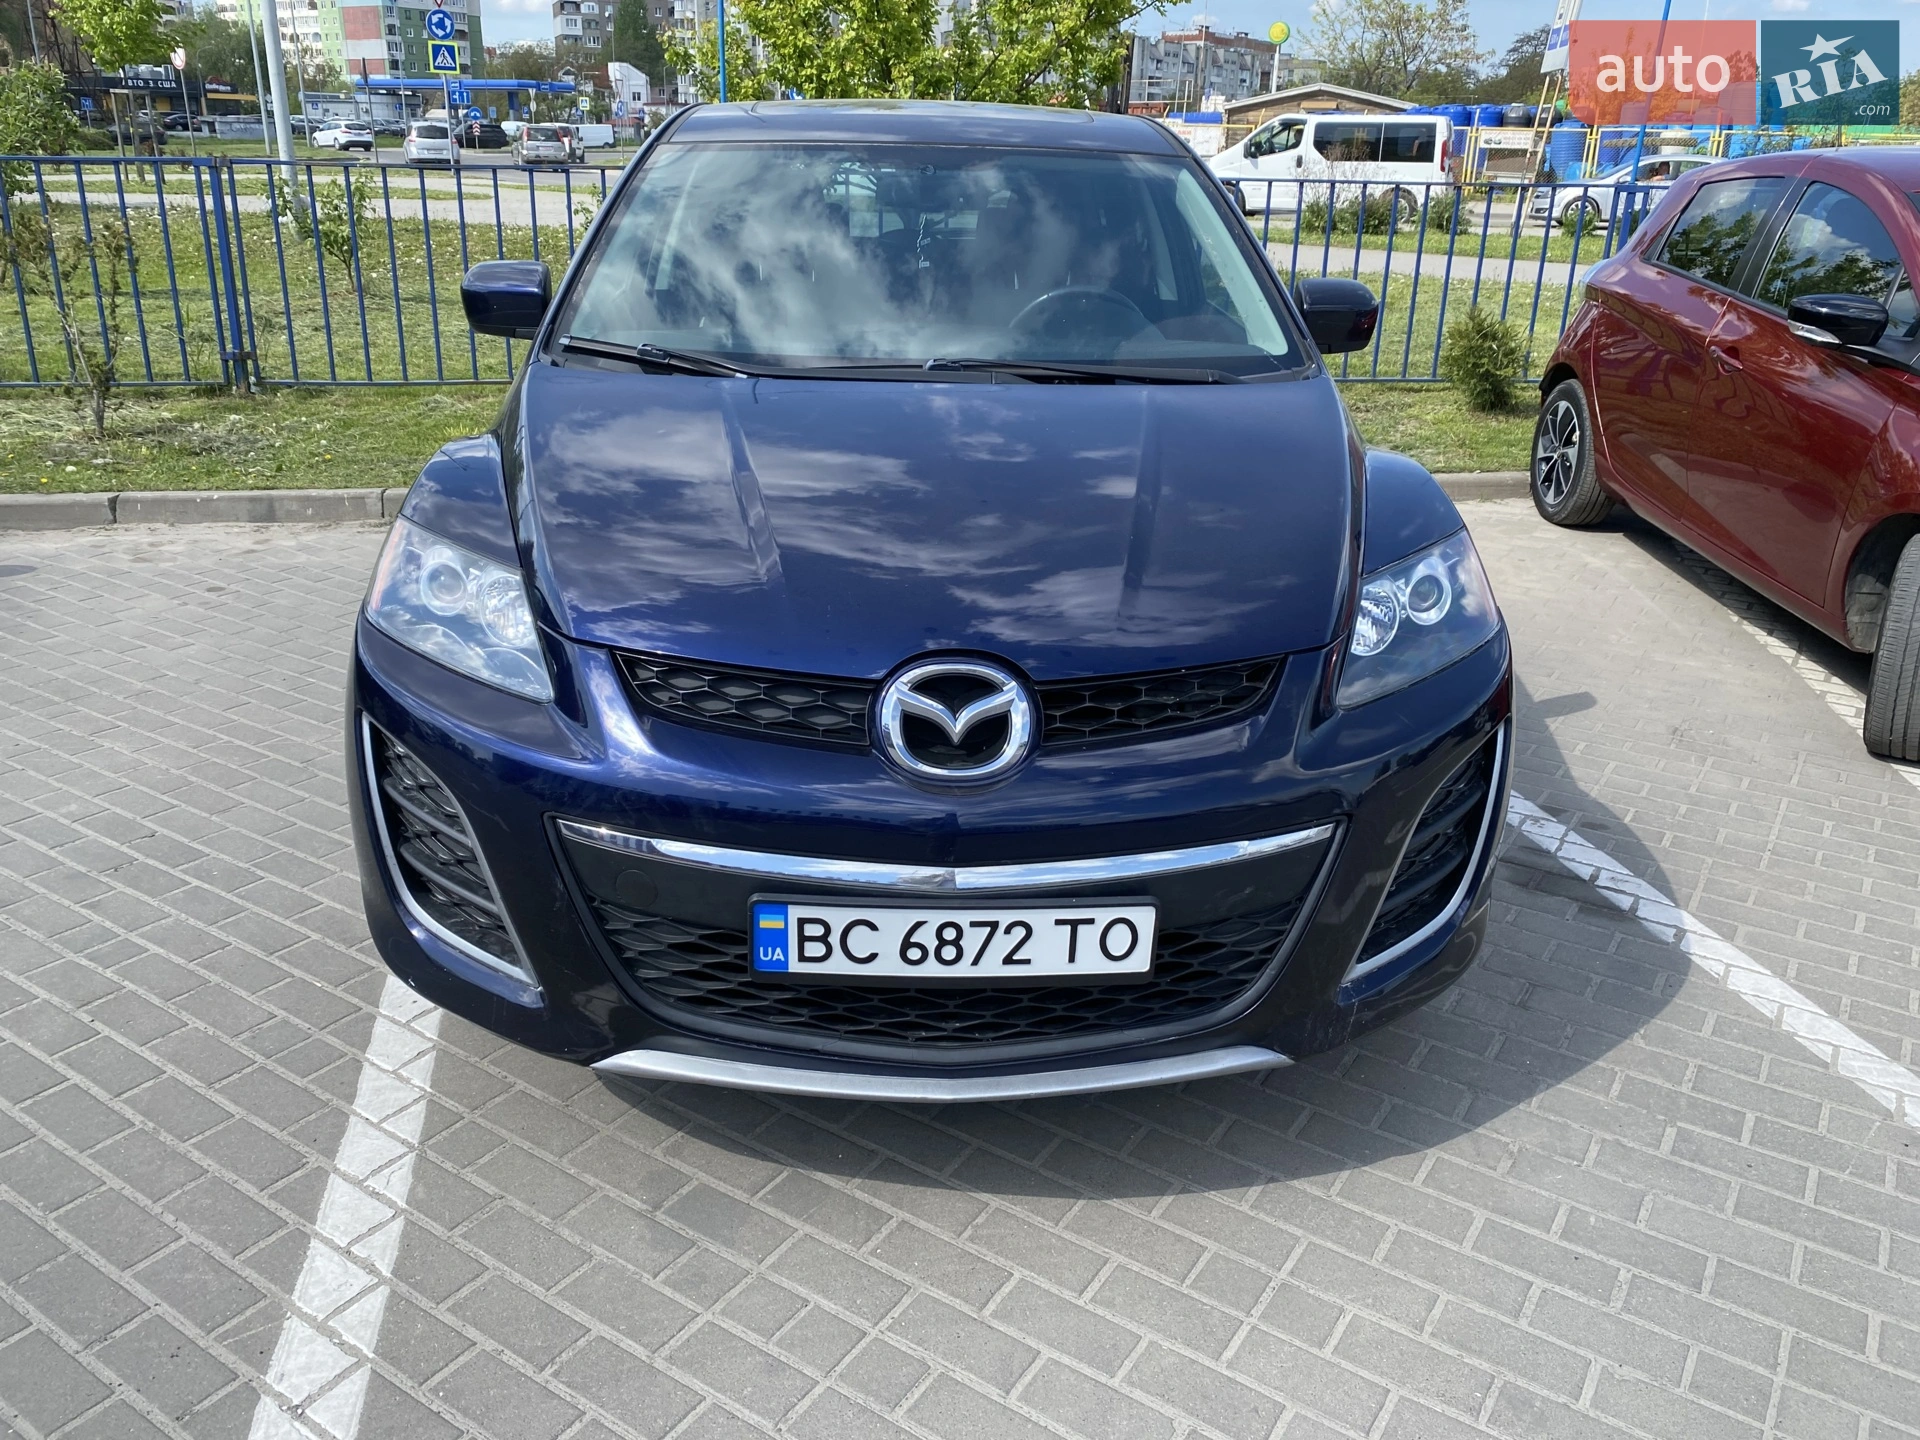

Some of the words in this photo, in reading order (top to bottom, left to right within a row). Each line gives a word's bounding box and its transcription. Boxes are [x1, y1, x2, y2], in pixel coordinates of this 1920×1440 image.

[157, 80, 177, 88] США
[797, 917, 879, 965] BC
[899, 919, 1033, 967] 6872
[1054, 916, 1139, 964] TO
[759, 947, 785, 961] UA
